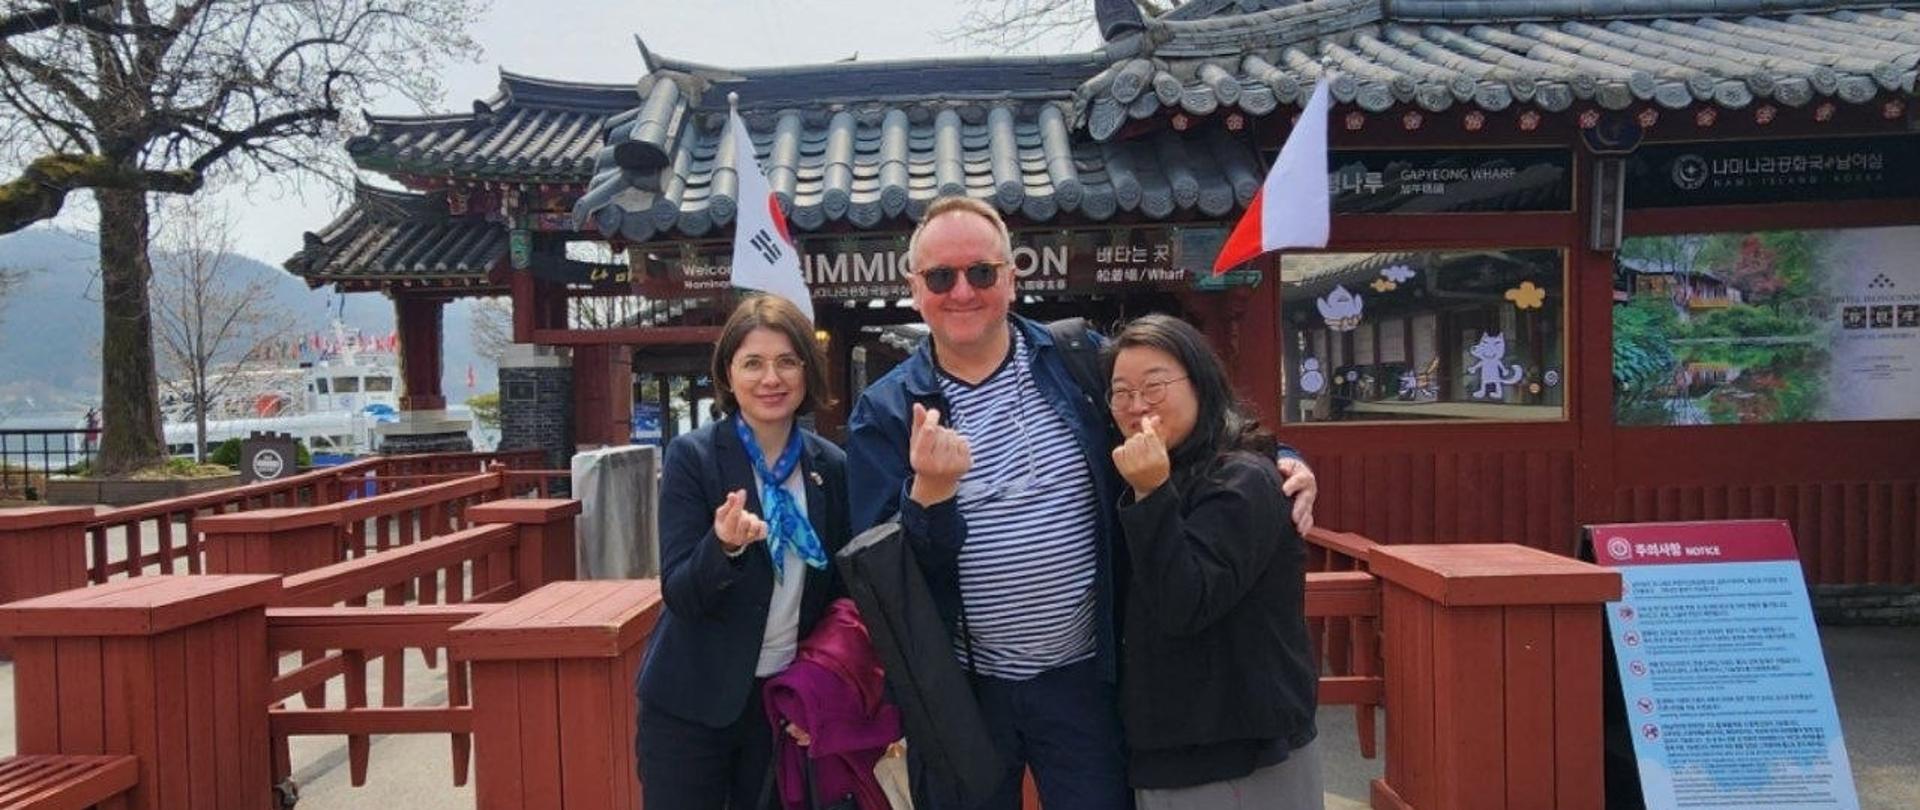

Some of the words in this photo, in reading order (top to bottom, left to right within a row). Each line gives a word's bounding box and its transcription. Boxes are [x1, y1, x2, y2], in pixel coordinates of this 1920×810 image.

[1401, 168, 1468, 181] GAPYEONG
[1471, 166, 1516, 181] WHARF
[1097, 244, 1147, 263] 배타는
[1153, 244, 1169, 262] 곳
[682, 263, 732, 275] Welco
[804, 246, 1068, 284] IMMION
[1635, 542, 1681, 557] 주의사항
[1685, 545, 1720, 556] NOTICE
